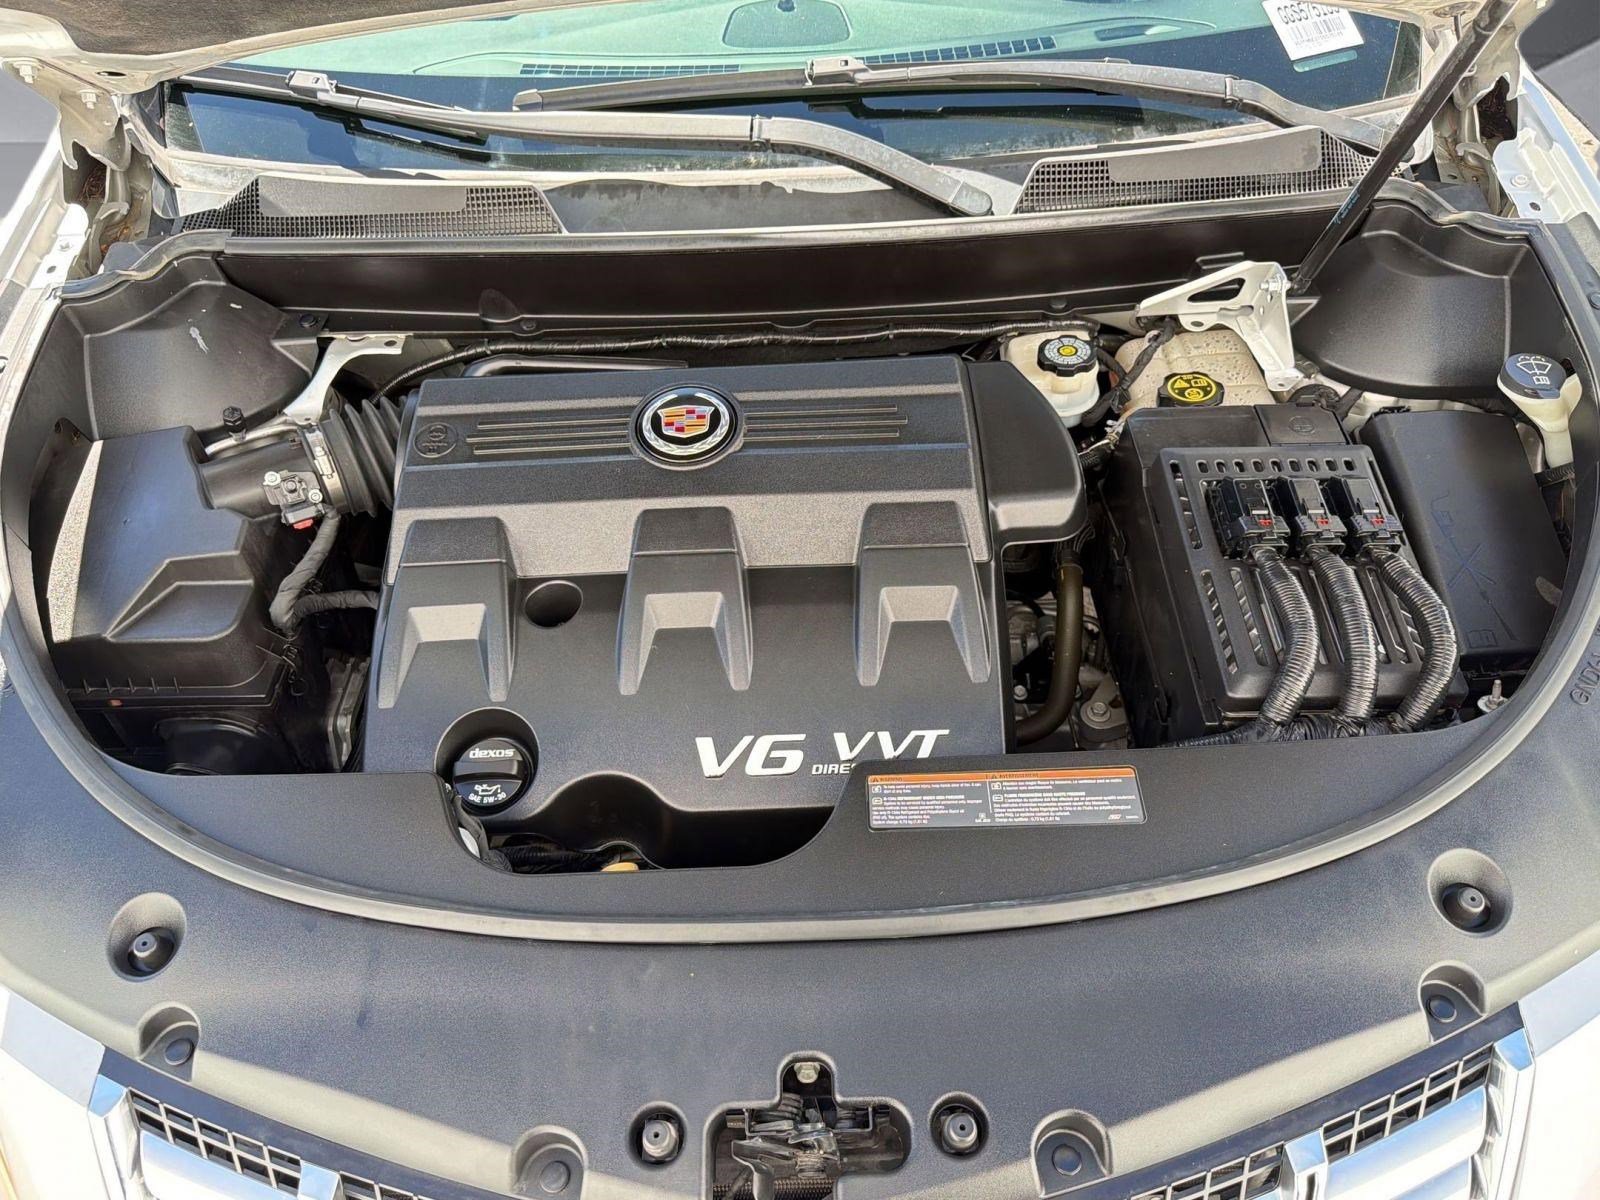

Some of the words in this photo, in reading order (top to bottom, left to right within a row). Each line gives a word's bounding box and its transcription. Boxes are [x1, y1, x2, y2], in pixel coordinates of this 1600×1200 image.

[469, 747, 516, 759] dexos
[695, 735, 806, 778] V6
[833, 729, 950, 761] VVT
[811, 763, 857, 775] DIRE
[468, 793, 482, 803] SAE
